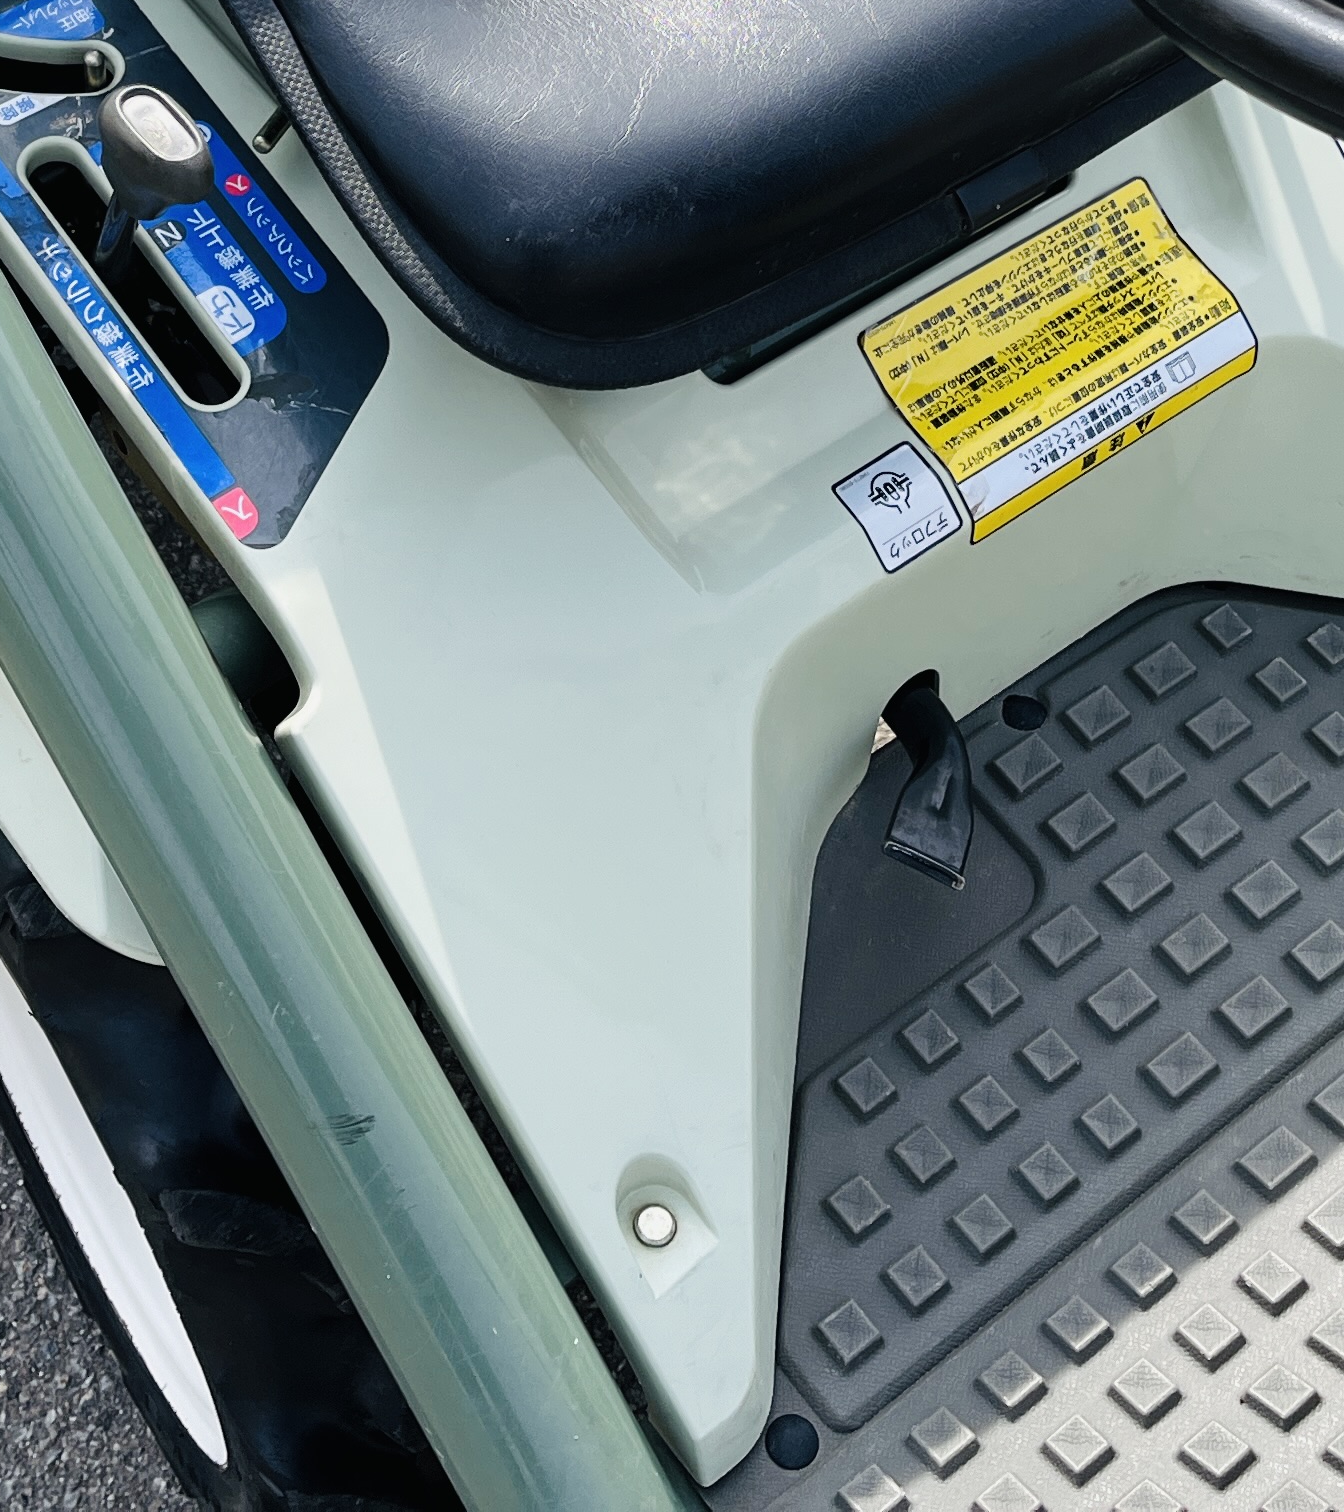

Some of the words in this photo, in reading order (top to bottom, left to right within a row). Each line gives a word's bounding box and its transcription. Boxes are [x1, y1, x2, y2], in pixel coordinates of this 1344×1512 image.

[57, 7, 98, 33] 油圧
[226, 174, 249, 192] 入
[154, 221, 184, 249] N
[246, 196, 315, 285] バックアップ
[186, 208, 276, 311] 作業機上下
[36, 237, 155, 392] 作業機クラッチ
[211, 290, 253, 337] 下げ
[221, 495, 253, 521] 入
[890, 511, 949, 559] デフロック
